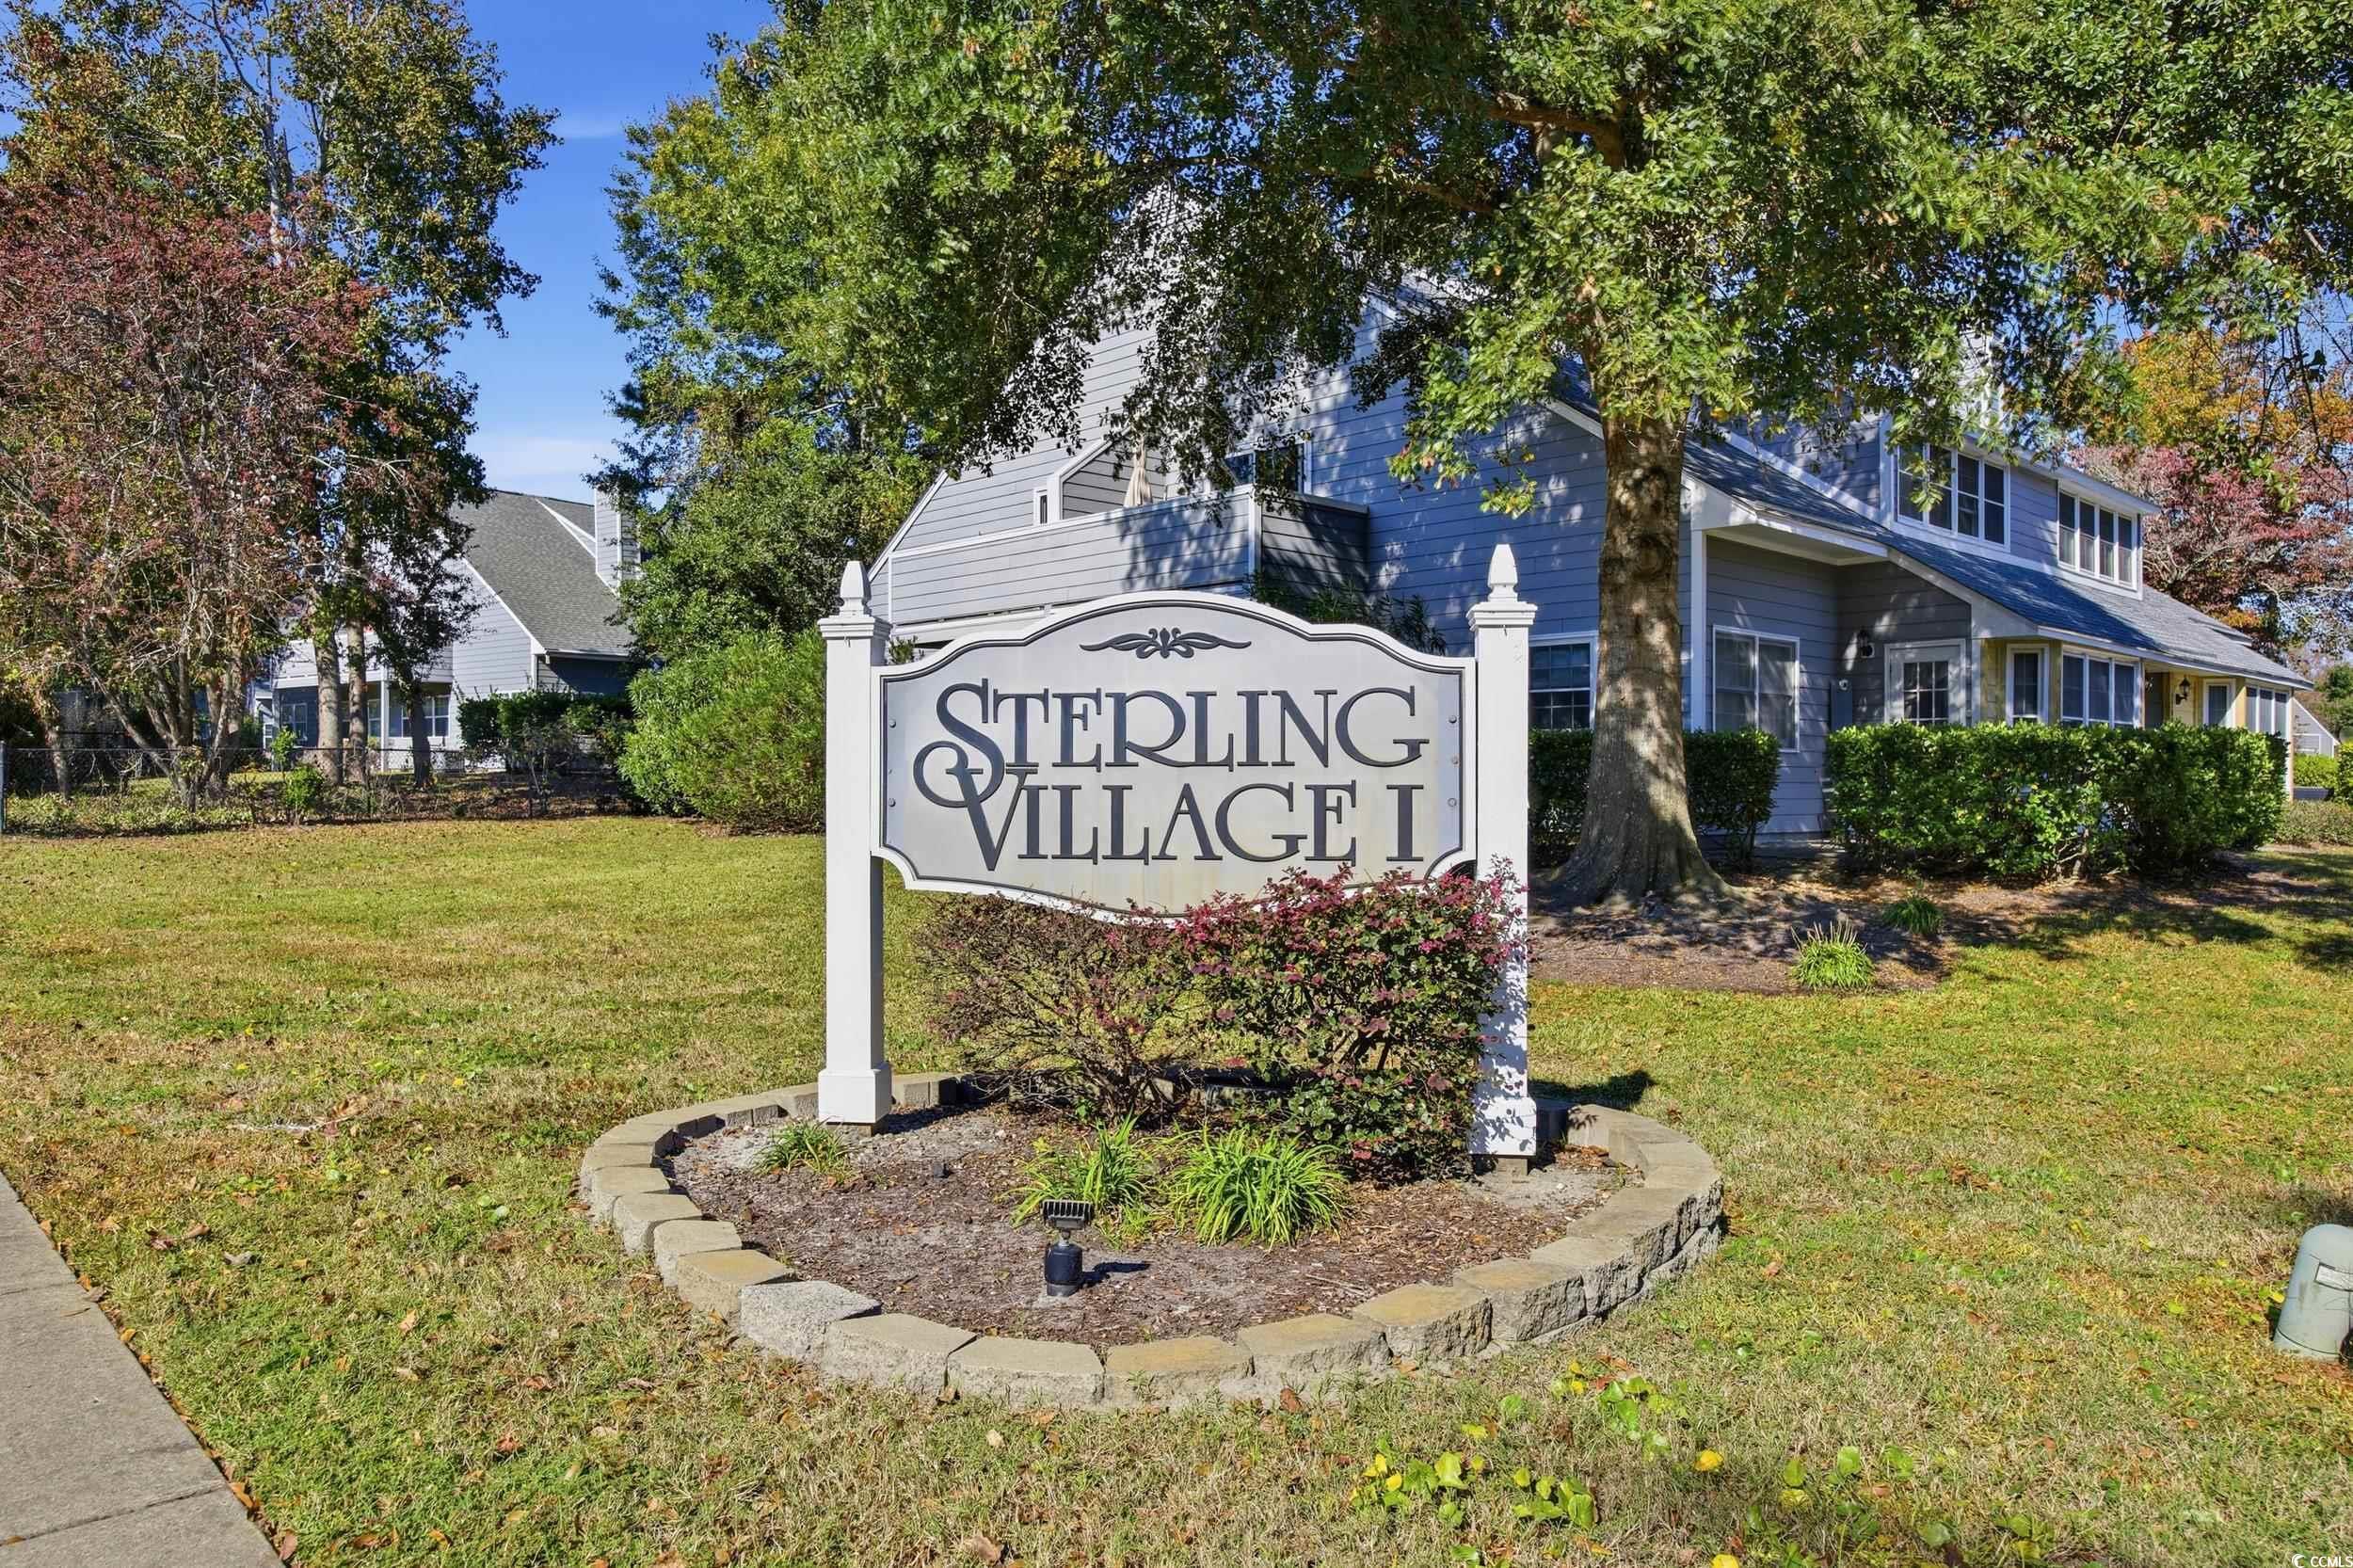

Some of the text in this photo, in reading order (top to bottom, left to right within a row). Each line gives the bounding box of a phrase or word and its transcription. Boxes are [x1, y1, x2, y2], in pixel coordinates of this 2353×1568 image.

[913, 678, 1430, 808] STERLING
[945, 768, 1424, 872] VILLAGE I
